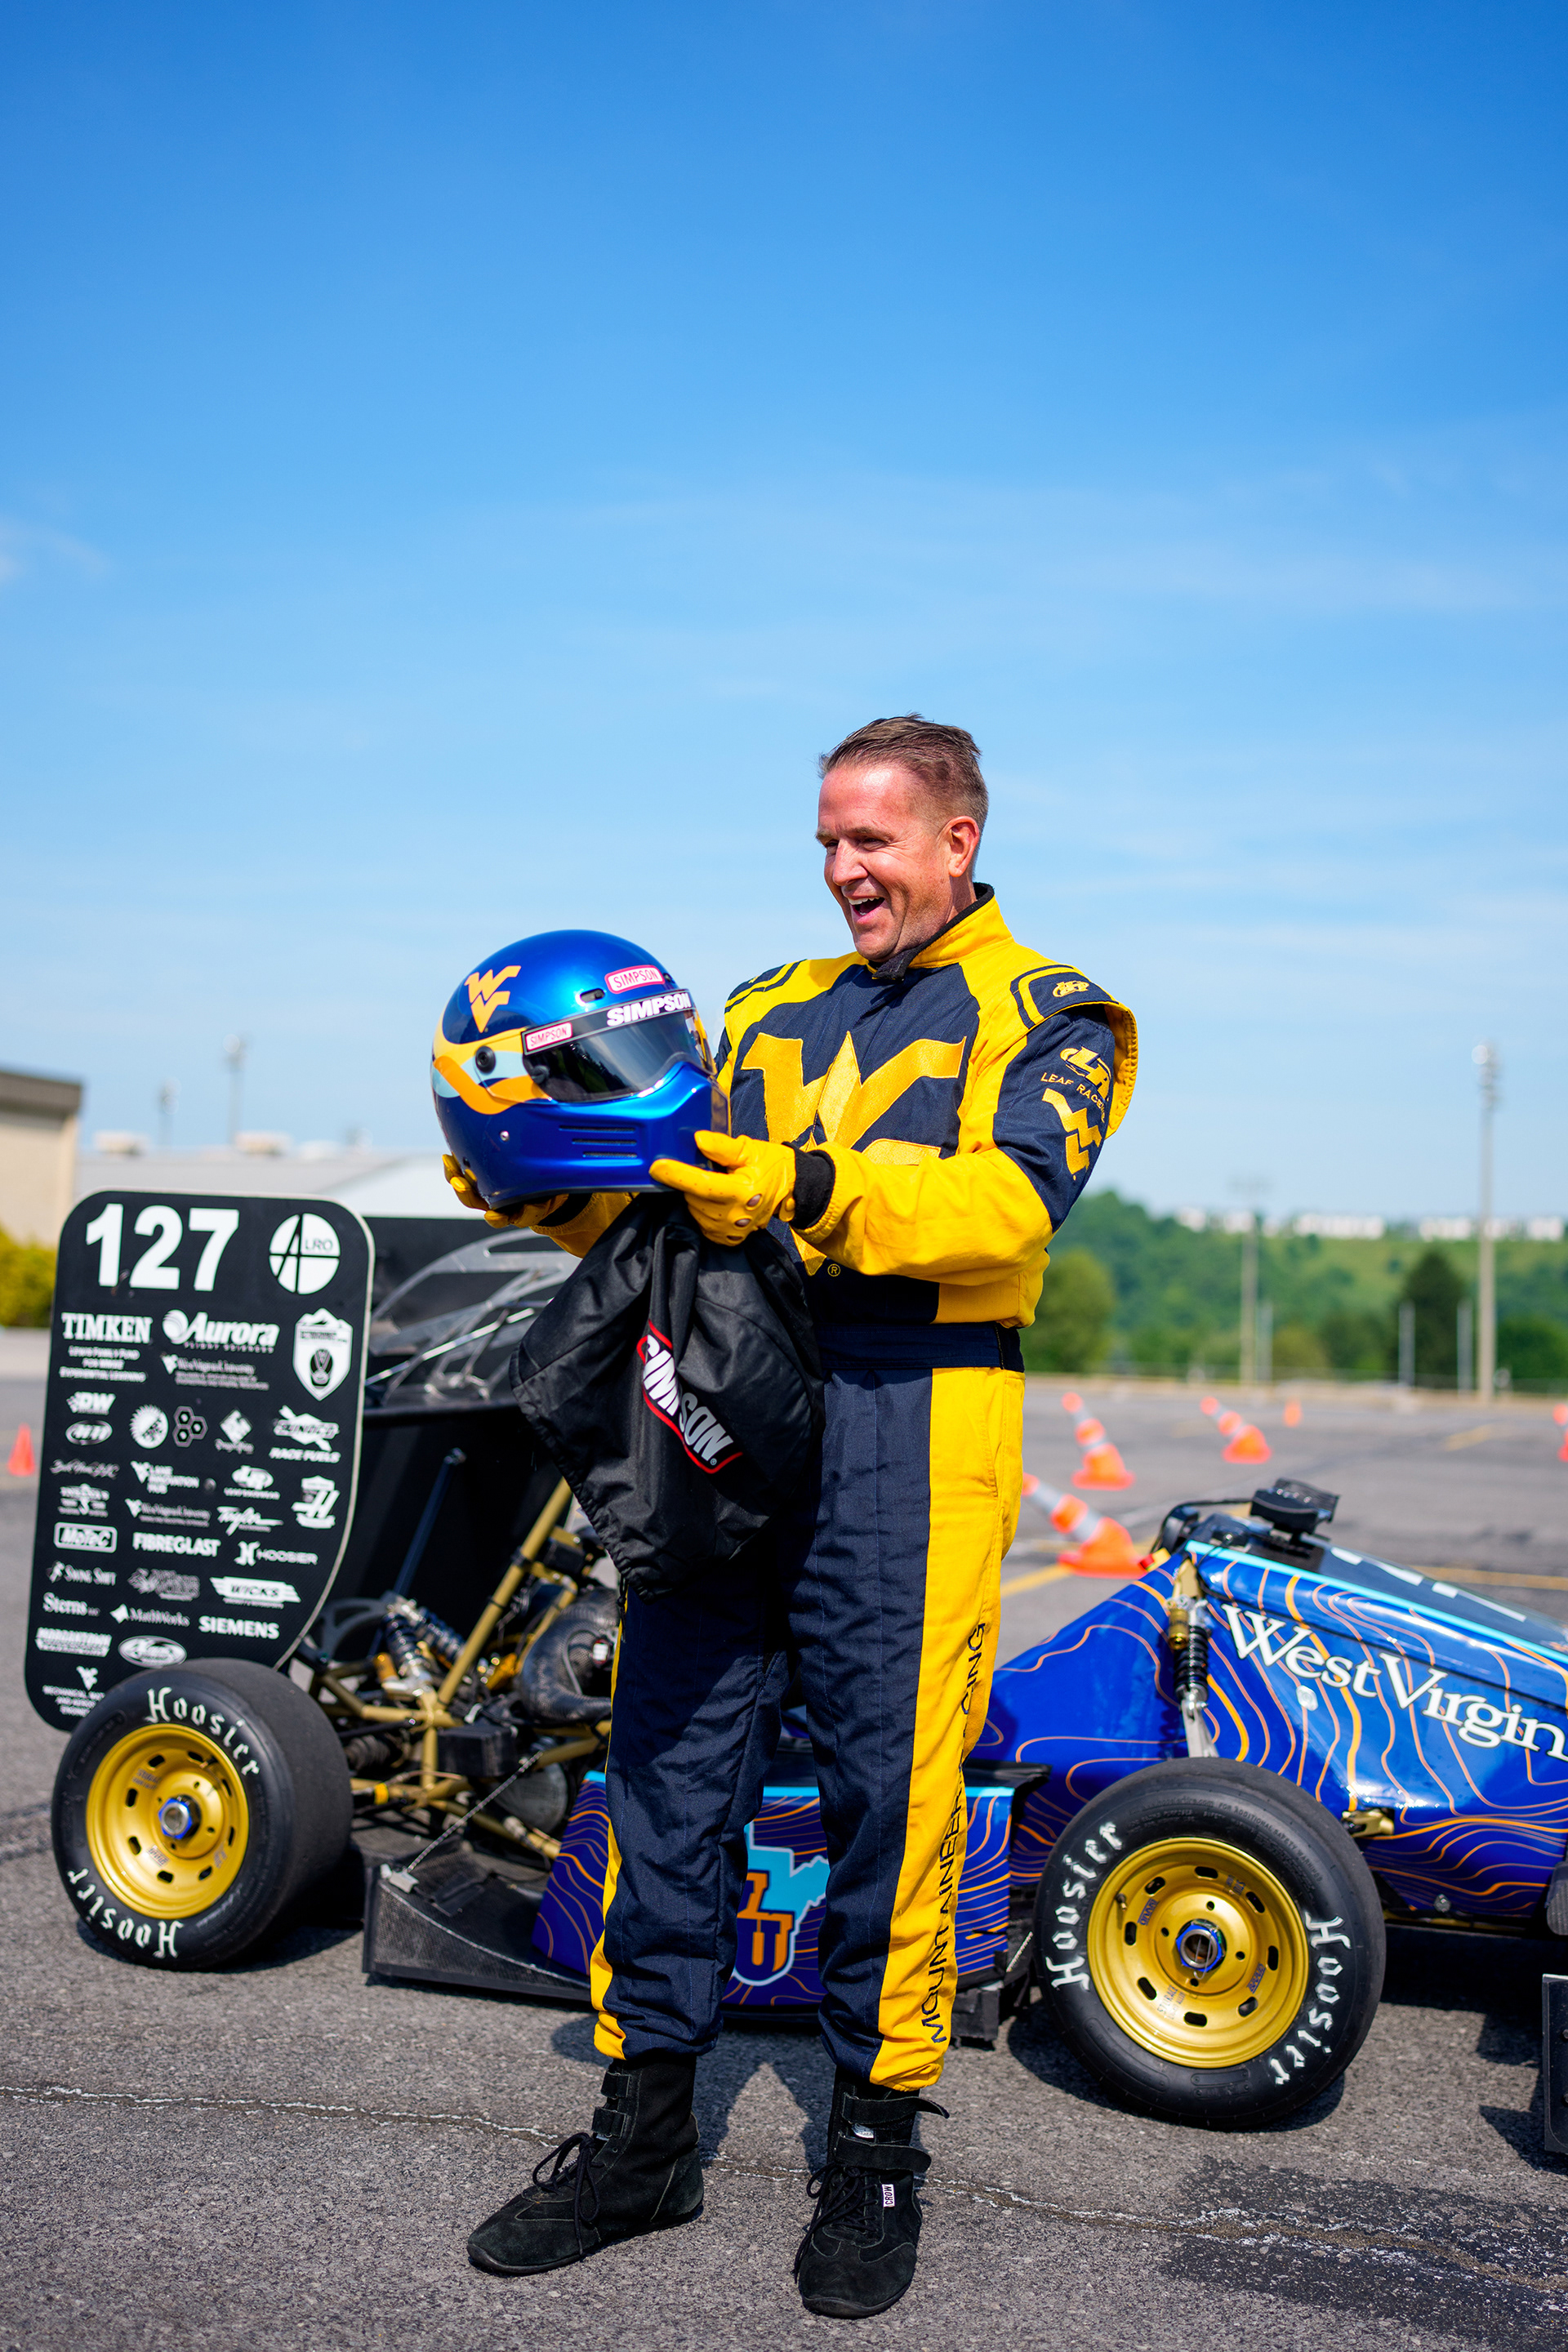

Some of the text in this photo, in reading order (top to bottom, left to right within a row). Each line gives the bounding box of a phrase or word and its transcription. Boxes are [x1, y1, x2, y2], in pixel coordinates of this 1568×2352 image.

[613, 969, 658, 988] SIMPSON
[607, 993, 691, 1027] SIMPSON
[530, 1026, 568, 1047] SIMPSON
[1040, 1072, 1075, 1085] LEAF
[86, 1203, 239, 1291] 127
[61, 1312, 153, 1343] TIMKEN
[186, 1311, 281, 1347] Aurora
[643, 1334, 733, 1462] SIMSON
[303, 1449, 341, 1463] FUELS
[60, 1526, 111, 1547] MoTeC
[132, 1532, 221, 1557] FIBREGLAST
[256, 1548, 318, 1565] HOOSIER
[231, 1584, 279, 1597] WICKS
[129, 1607, 190, 1627] MathWorks
[198, 1615, 279, 1639] SIEMENS
[1222, 1603, 1568, 1762] West Virgin
[145, 1687, 260, 1775] Hoosier
[68, 1867, 185, 1958] Hoosier
[1045, 1821, 1124, 1992] Hoosier
[1269, 1911, 1352, 2085] Hoosier
[884, 2185, 894, 2206] CROW
